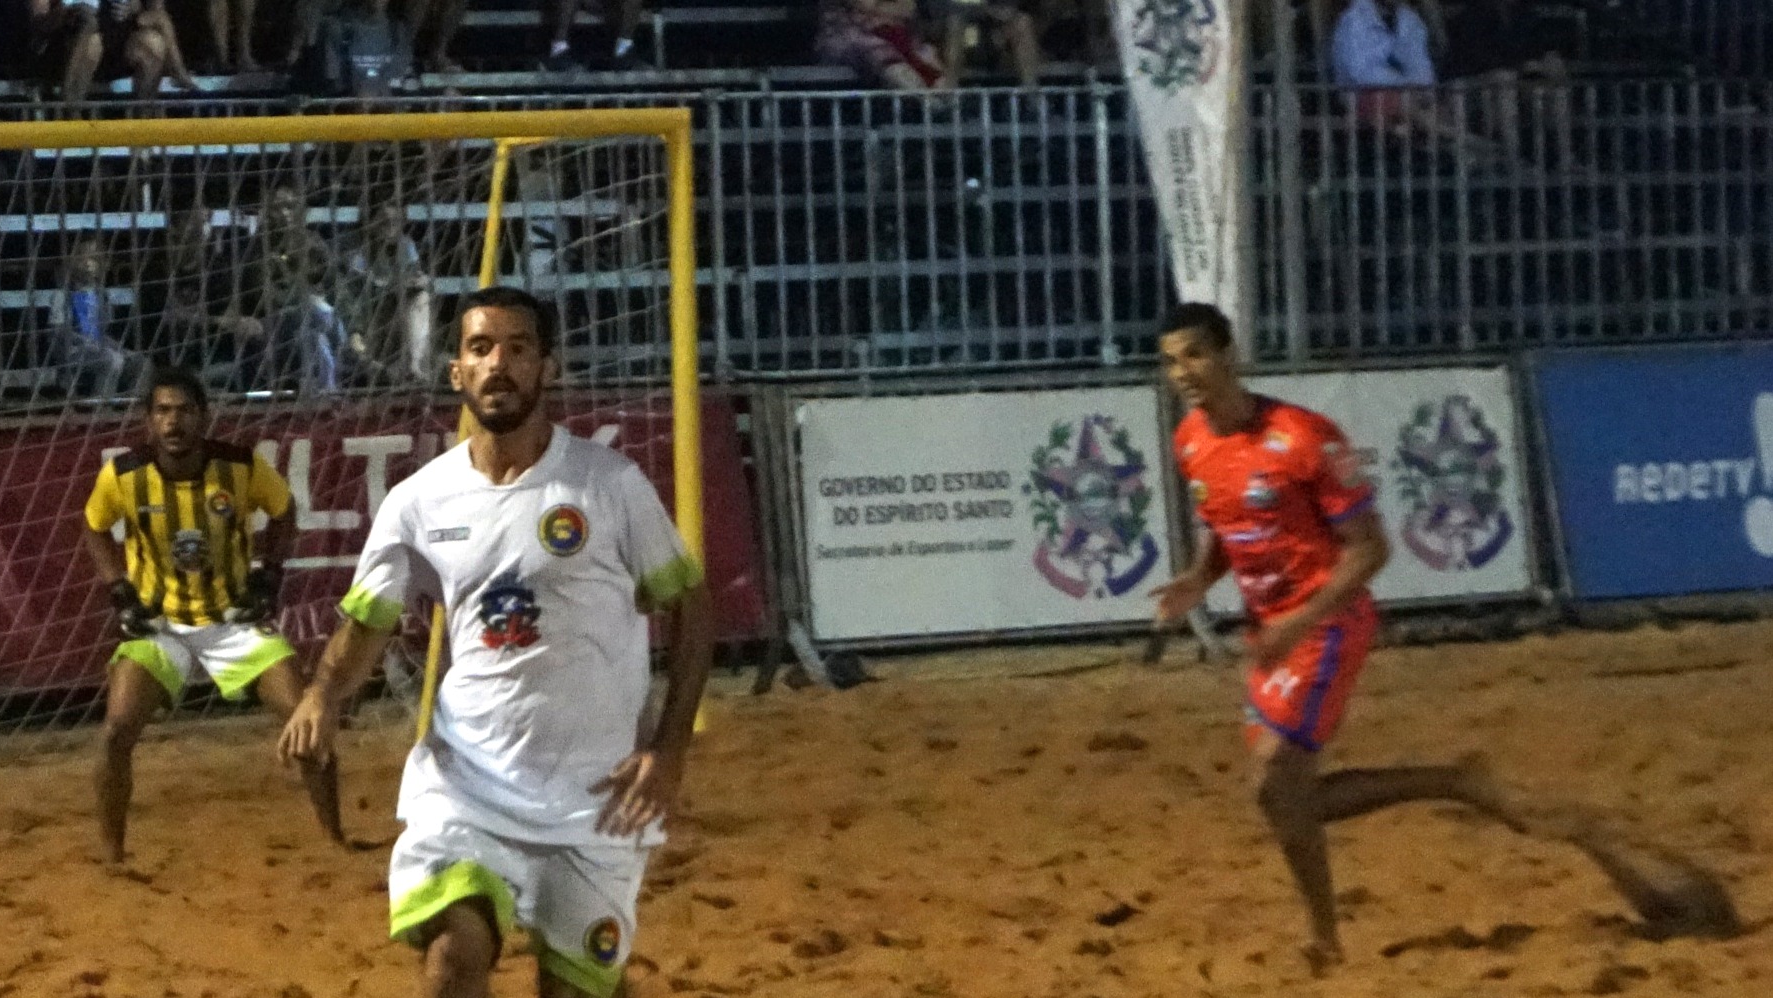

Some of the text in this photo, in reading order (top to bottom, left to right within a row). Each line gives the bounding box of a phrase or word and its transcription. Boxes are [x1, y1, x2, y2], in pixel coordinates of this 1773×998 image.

[819, 469, 1011, 498] GOVERNO DO ESTADO
[833, 505, 859, 526] DO
[953, 499, 1014, 521] SANTO
